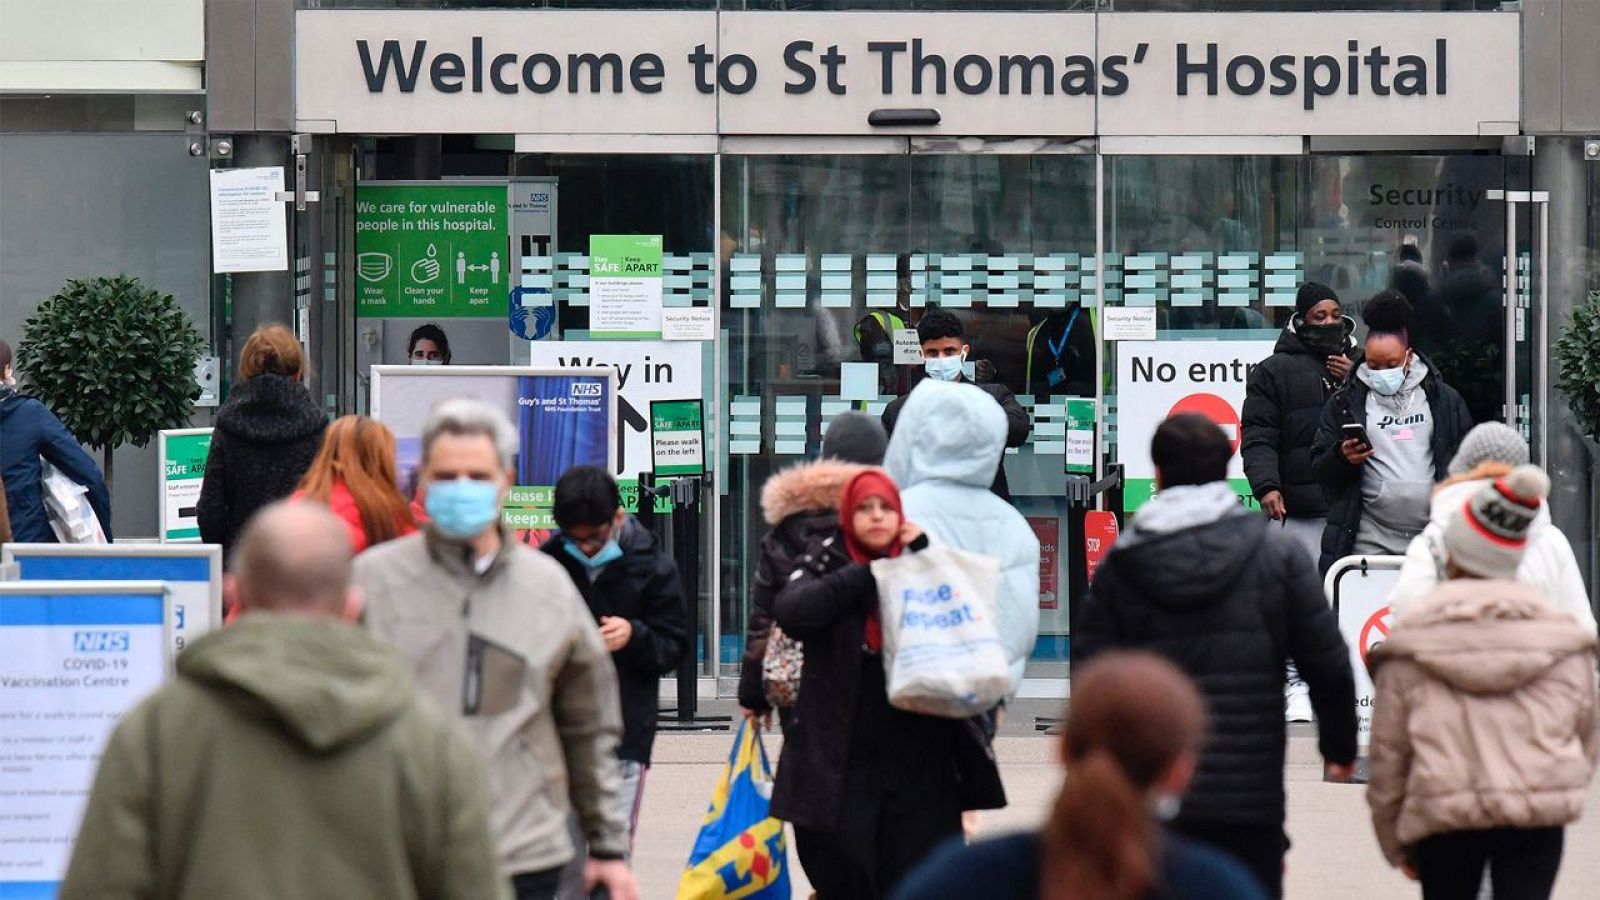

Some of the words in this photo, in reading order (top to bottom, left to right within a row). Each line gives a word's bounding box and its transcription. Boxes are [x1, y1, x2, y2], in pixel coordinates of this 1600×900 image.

[356, 37, 664, 95] Welcome
[688, 44, 757, 96] to
[784, 41, 846, 96] St
[880, 39, 1149, 96] Thomas'
[1177, 39, 1448, 110] Hospital
[1369, 184, 1481, 213] Security
[356, 202, 376, 213] We
[380, 205, 405, 213] care
[409, 201, 427, 213] for
[431, 201, 496, 213] vulnerable
[356, 219, 399, 233] people
[403, 219, 414, 230] in
[418, 219, 440, 230] this
[444, 219, 496, 233] hospital.
[1374, 217, 1426, 228] Control
[594, 263, 619, 272] SAFE
[624, 264, 658, 272] APART
[405, 287, 424, 295] Clean
[427, 288, 444, 297] your
[470, 287, 488, 297] Keep
[470, 299, 489, 307] apart
[645, 355, 673, 383] in
[1131, 357, 1176, 382] No
[1188, 358, 1257, 382] entr
[572, 384, 600, 396] NHS
[518, 397, 540, 407] Guy's
[541, 398, 556, 406] and
[558, 398, 567, 406] St
[166, 465, 187, 476] SAFE
[506, 512, 539, 526] keep
[74, 632, 130, 651] NHS
[63, 658, 129, 671] COVID-19
[2, 677, 81, 688] Vaccination
[83, 676, 130, 688] Centre
